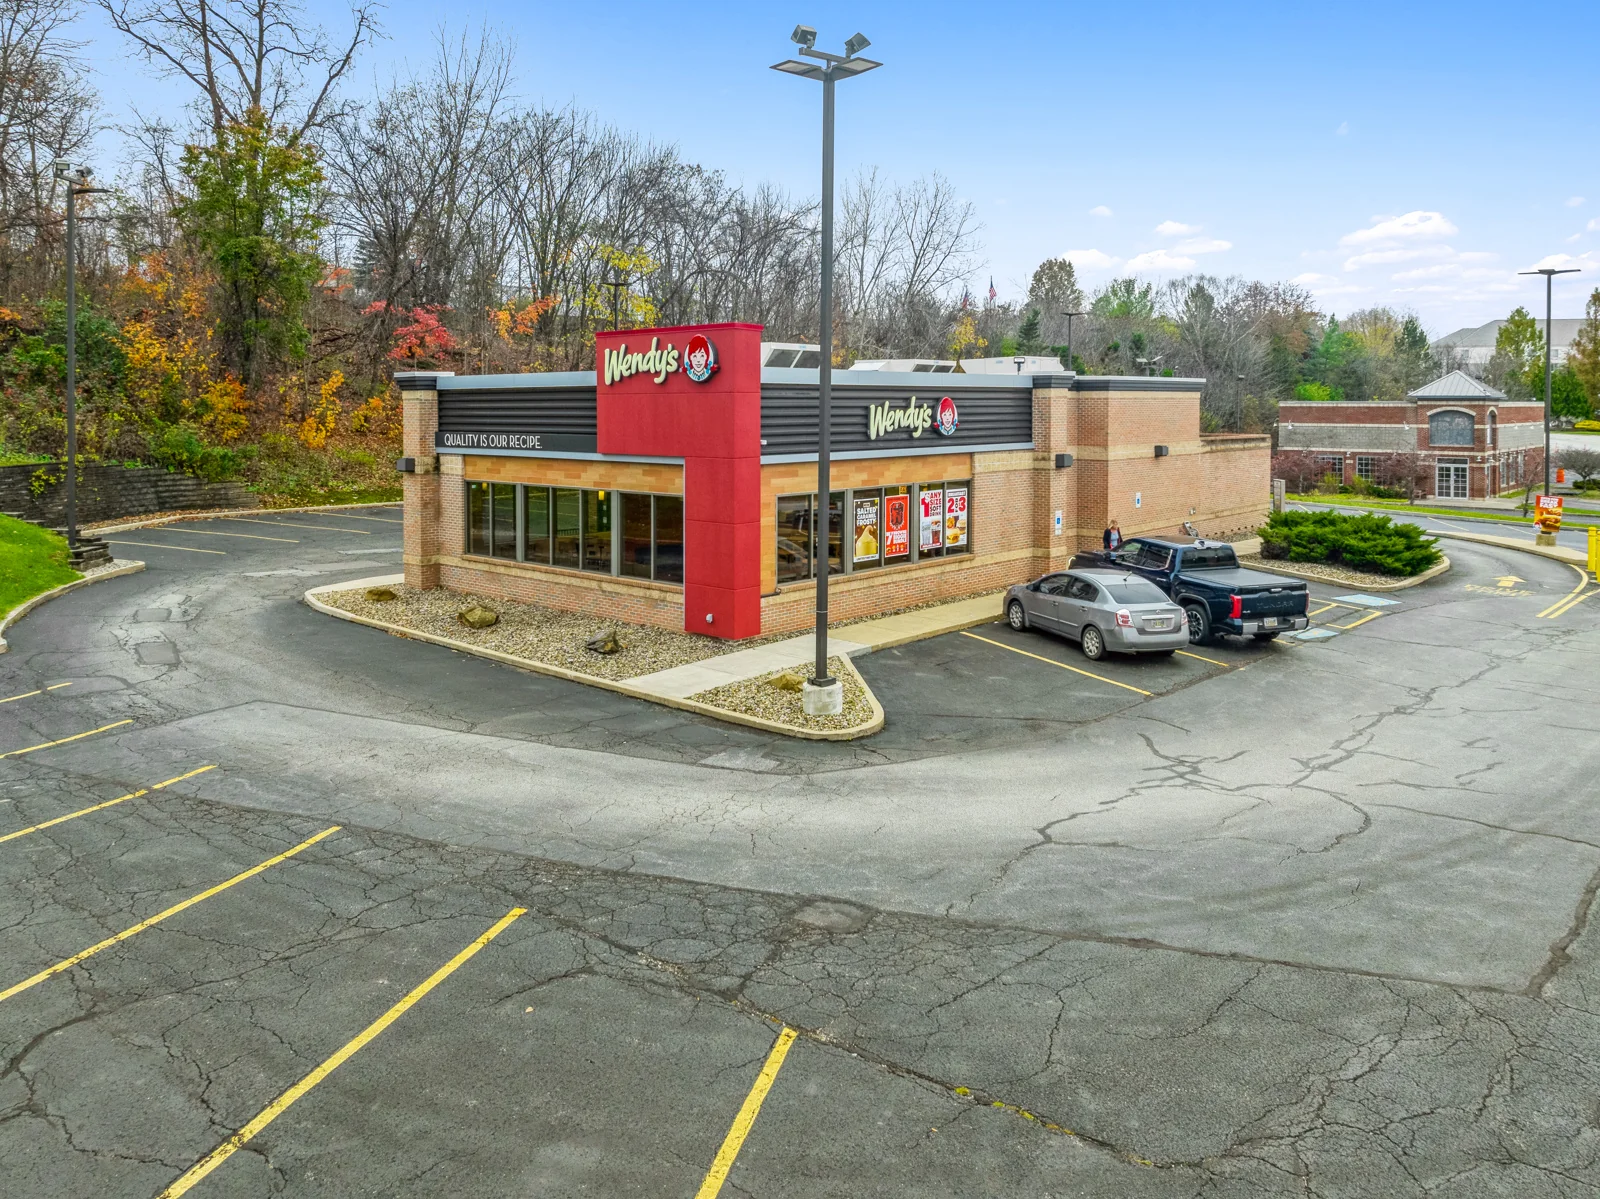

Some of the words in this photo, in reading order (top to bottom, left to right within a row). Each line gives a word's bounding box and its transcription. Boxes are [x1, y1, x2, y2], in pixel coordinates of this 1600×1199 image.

[604, 336, 679, 386] Wendy's
[869, 395, 932, 440] Wendy's
[444, 433, 478, 447] QUALITY
[480, 434, 487, 447] IS
[489, 434, 508, 448] OUR
[509, 435, 543, 449] RECIPE.
[930, 491, 942, 499] ANY
[930, 498, 942, 506] SIZE
[856, 507, 876, 515] SALTED
[947, 497, 955, 513] 2
